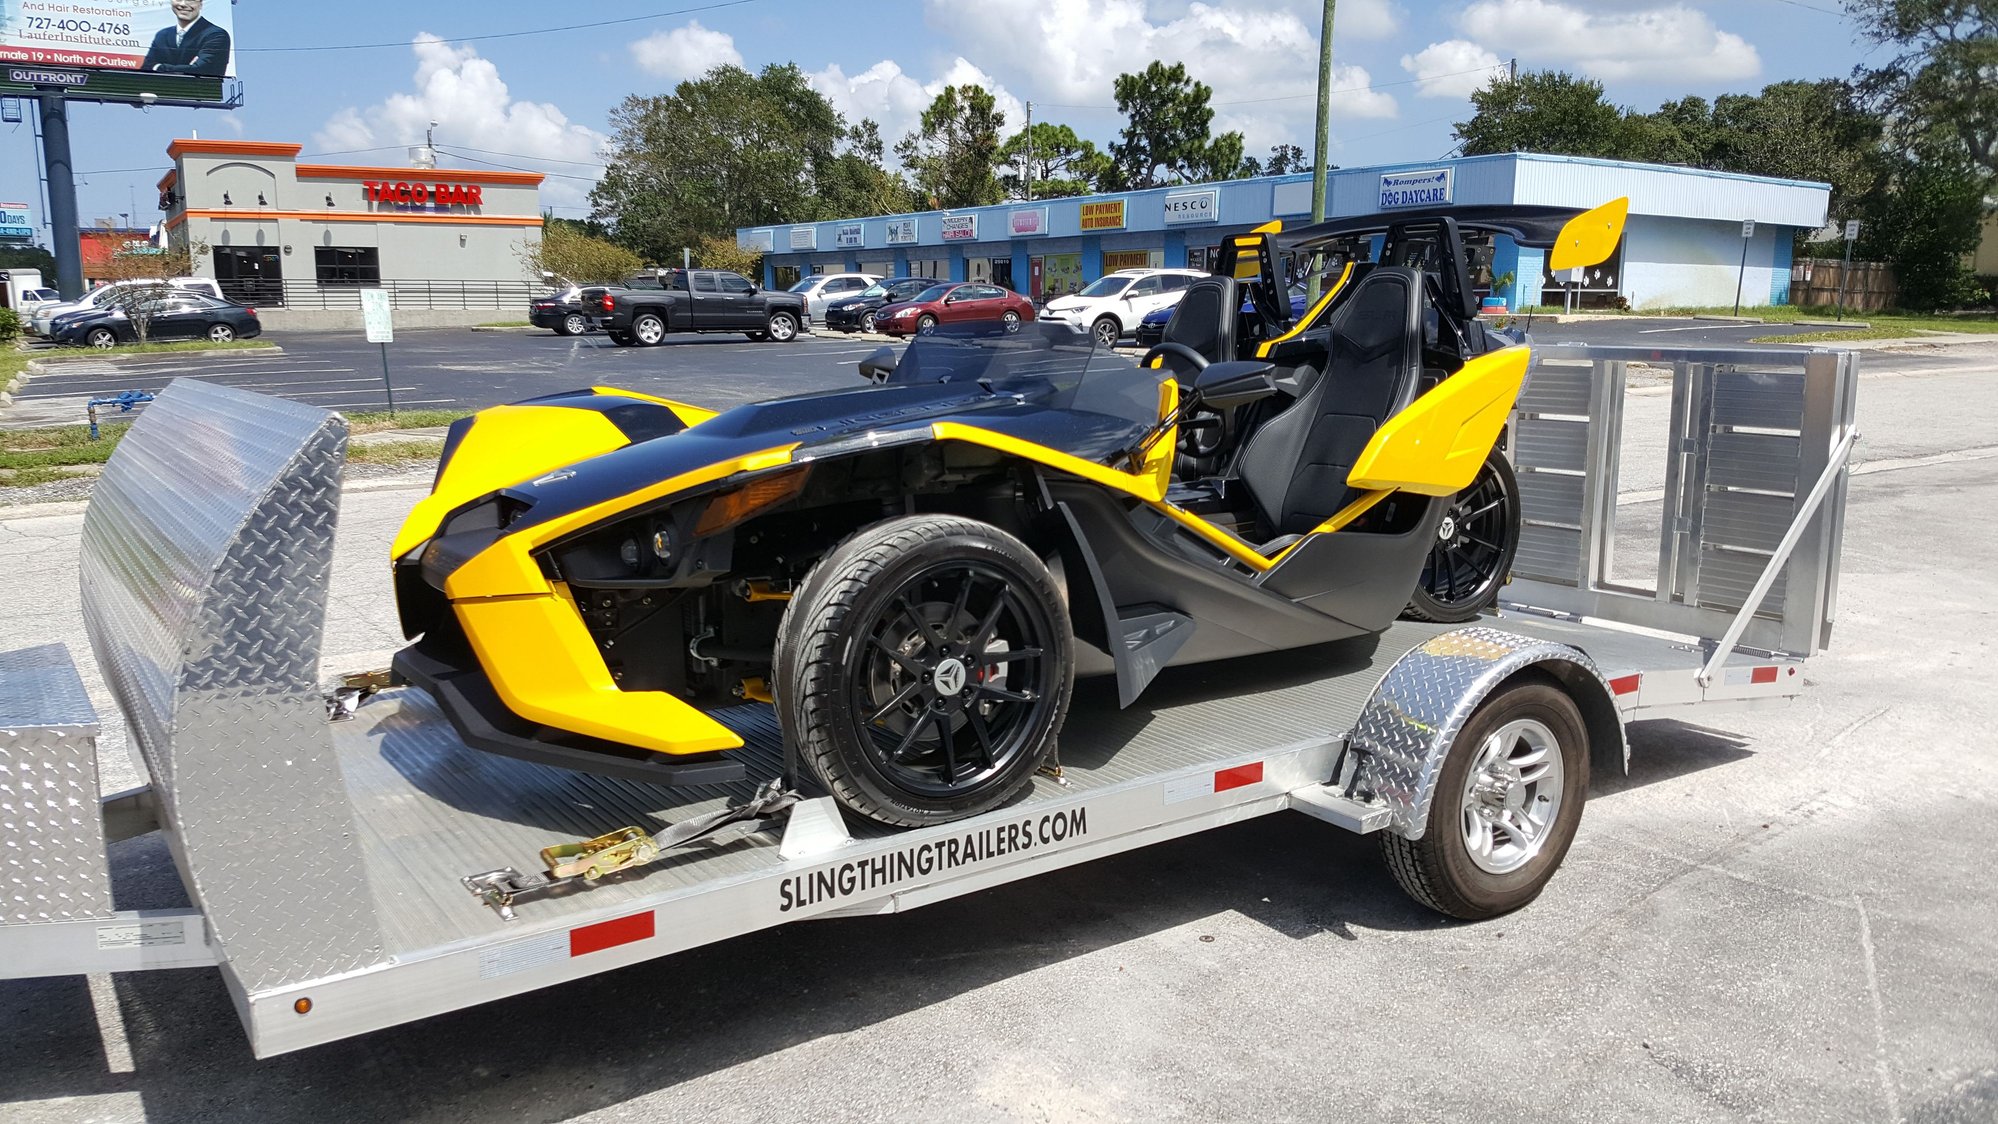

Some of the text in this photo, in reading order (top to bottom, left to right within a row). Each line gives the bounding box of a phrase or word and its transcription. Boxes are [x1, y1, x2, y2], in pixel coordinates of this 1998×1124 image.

[22, 1, 132, 18] And Hair Restoration
[26, 16, 131, 36] 727-400-4768
[18, 29, 140, 47] LauferInstitute.com
[31, 51, 44, 61] 19
[54, 53, 80, 62] North
[89, 55, 98, 64] of
[98, 56, 137, 68] Curlew
[12, 71, 84, 84] OUTFRONT
[1392, 176, 1435, 186] Rompers!
[363, 181, 483, 206] TACO BAR
[1381, 187, 1445, 206] DOG DAYCARE
[1082, 202, 1121, 216] LOW PAYMENT
[1164, 200, 1208, 212] NESCO
[7, 215, 25, 225] DAYS
[946, 222, 968, 230] CHANGES
[1082, 215, 1122, 228] AUTO INSURANCE
[955, 229, 974, 238] SALON
[1105, 252, 1146, 267] LOW PAYMENT
[779, 806, 1087, 912] SLINGTHINGTRAILERS.COM
